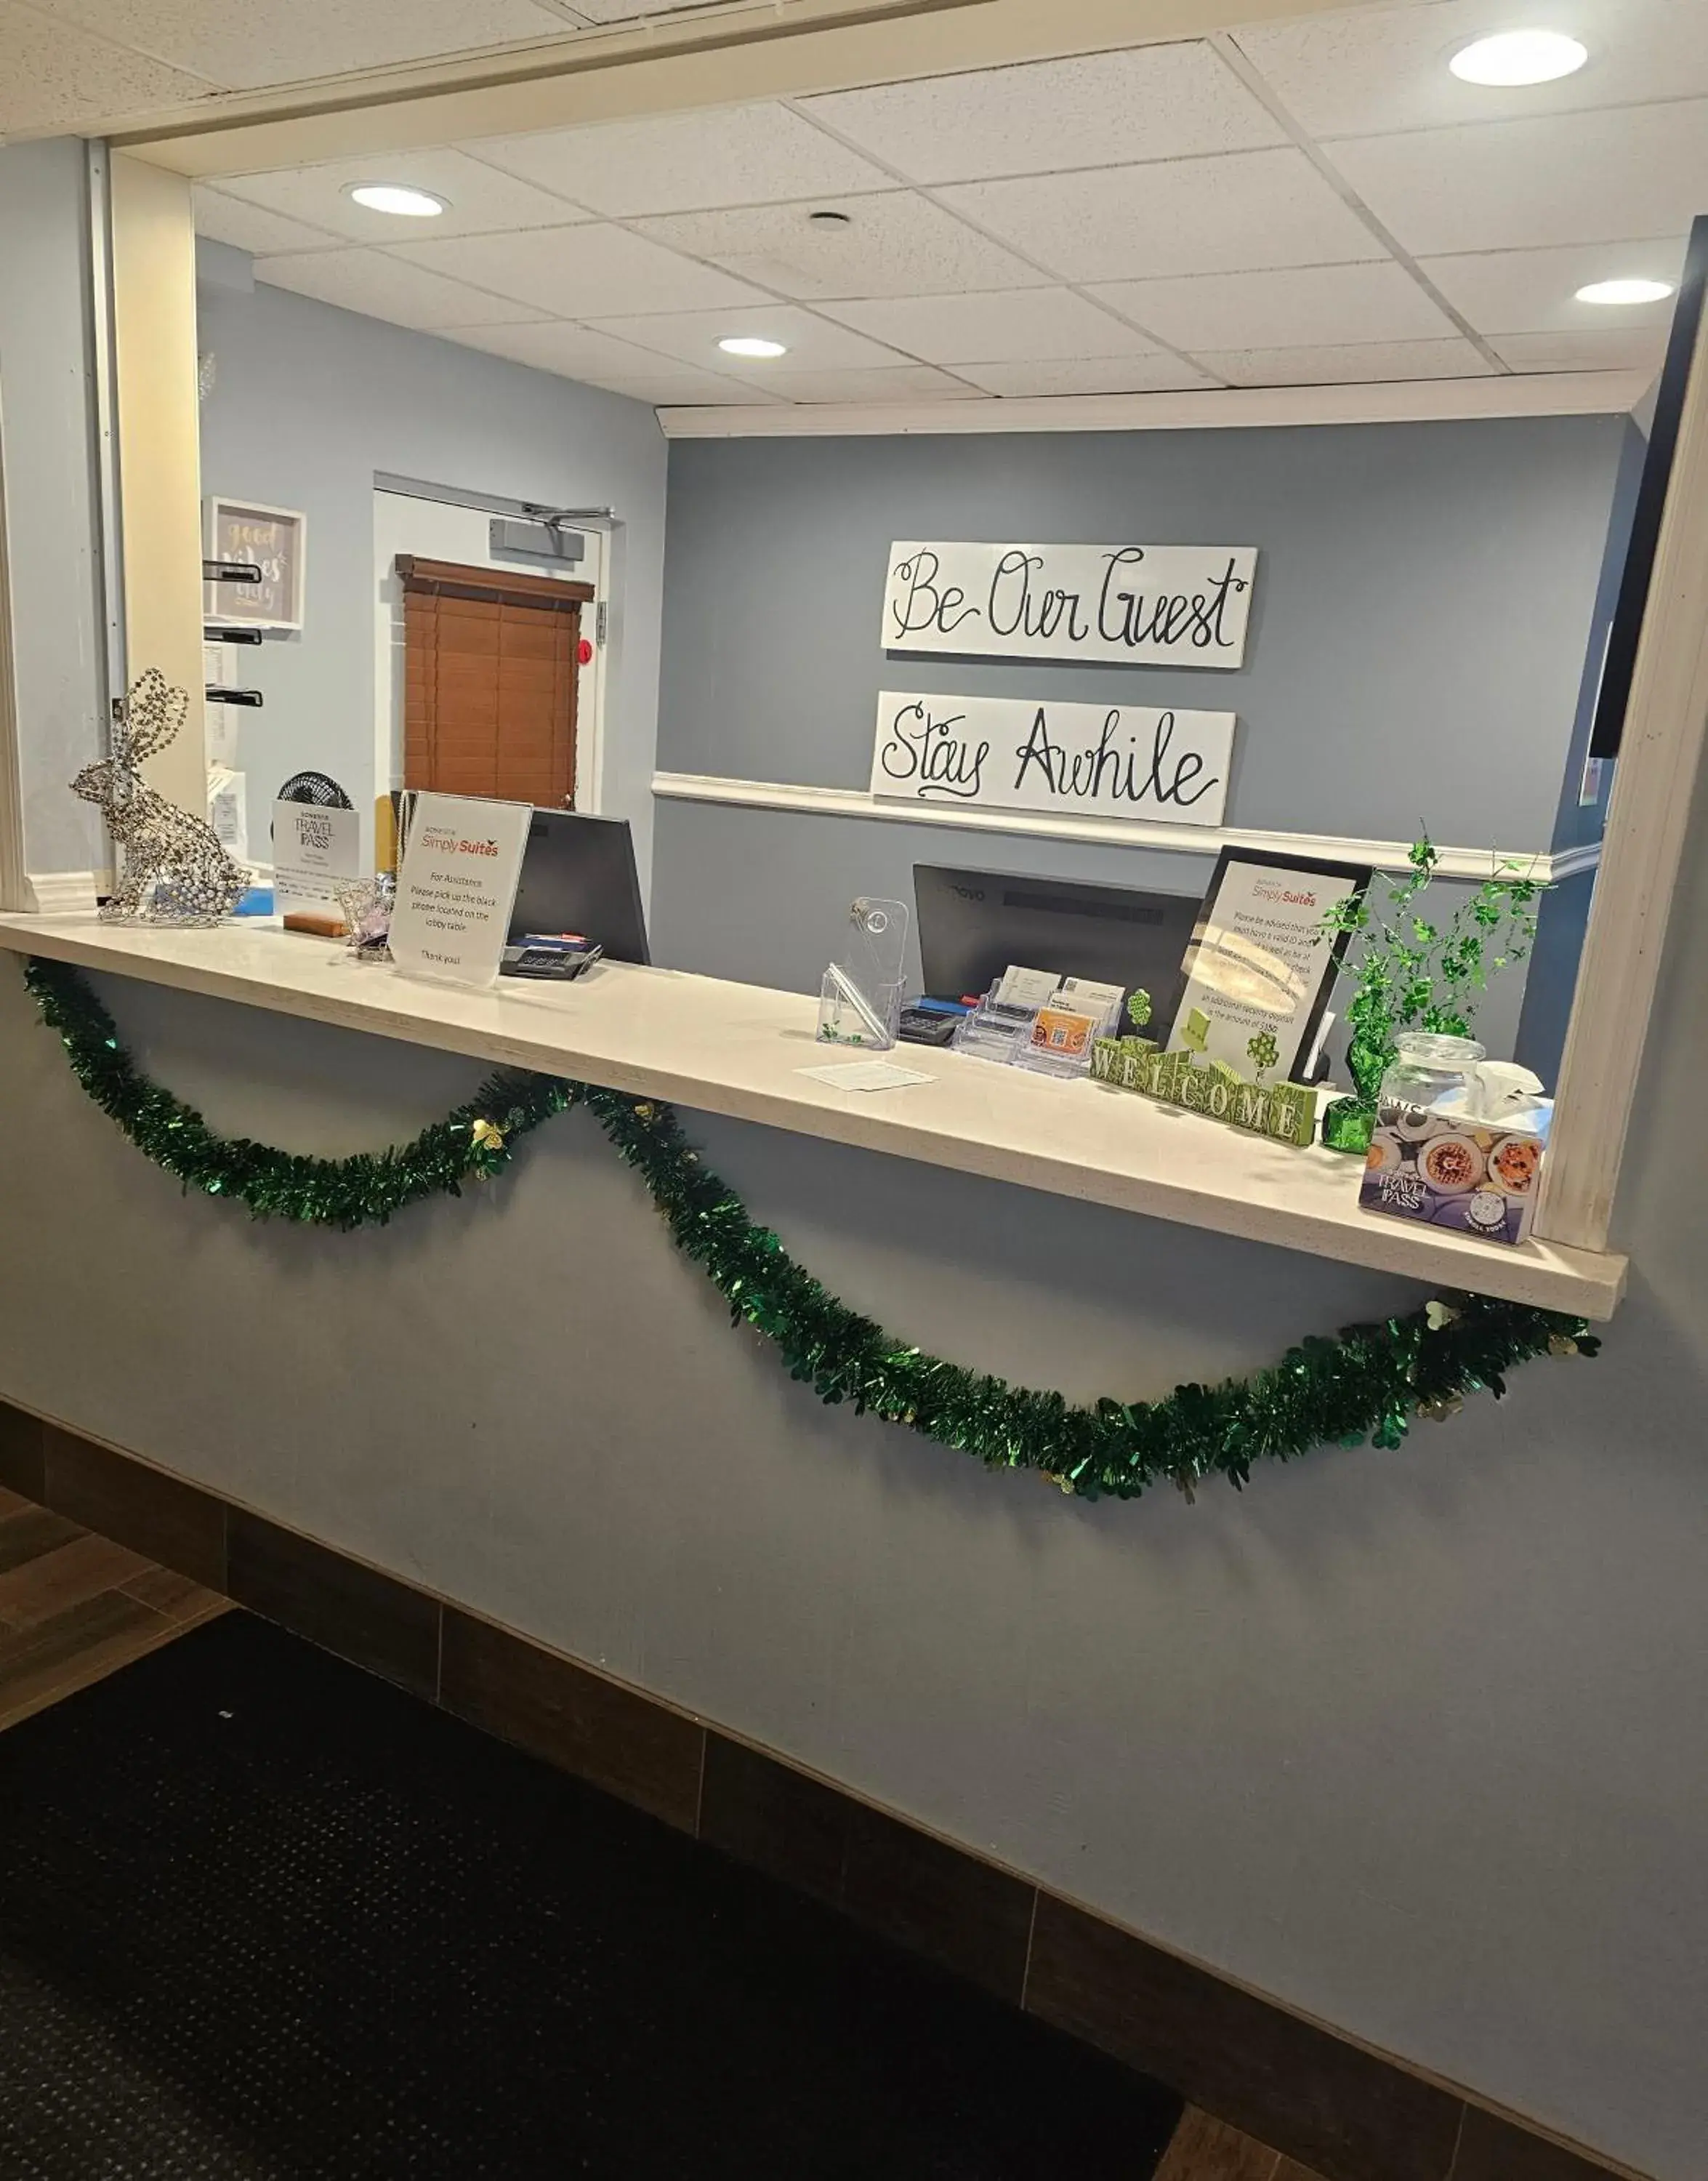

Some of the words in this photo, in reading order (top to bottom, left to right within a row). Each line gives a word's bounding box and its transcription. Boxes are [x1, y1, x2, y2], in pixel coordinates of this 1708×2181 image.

[893, 546, 981, 640] Be
[988, 550, 1089, 641] Our
[1097, 547, 1249, 648] Guest
[882, 700, 990, 798] Stay
[1014, 707, 1220, 806] Awhile
[296, 818, 335, 836] TRAVEL
[301, 832, 329, 849] PASS
[422, 833, 458, 854] Simply
[459, 839, 498, 856] Suites
[411, 885, 433, 897] Please
[435, 889, 450, 901] pick
[463, 893, 475, 904] the
[1282, 890, 1316, 907] Suites
[438, 905, 464, 917] located
[465, 910, 475, 919] on
[476, 911, 490, 922] the
[425, 917, 446, 931] lobby
[422, 948, 443, 962] Thank
[1092, 1048, 1296, 1138] WELCOME
[1382, 1189, 1420, 1209] PASS
